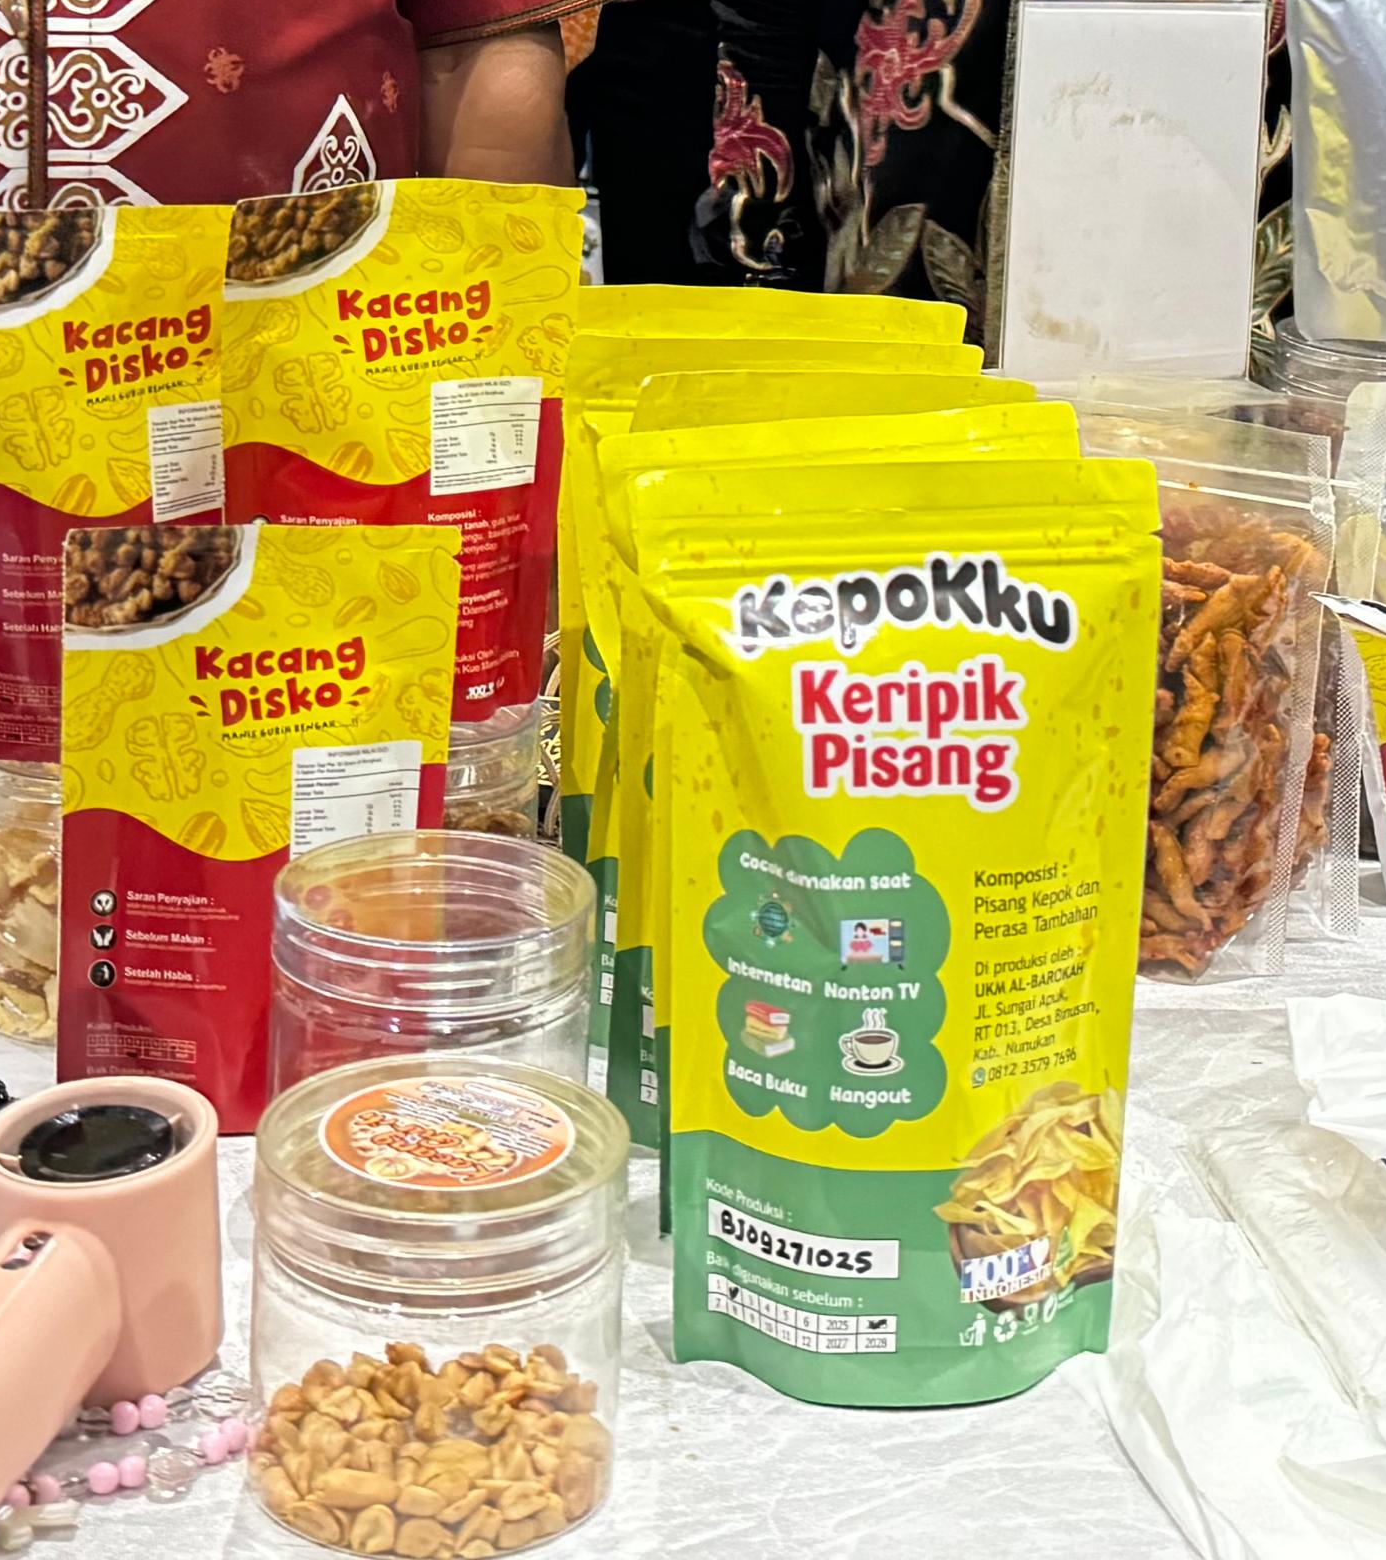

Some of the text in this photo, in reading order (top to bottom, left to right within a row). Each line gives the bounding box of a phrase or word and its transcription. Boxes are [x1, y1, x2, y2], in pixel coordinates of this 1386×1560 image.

[337, 280, 491, 321] Kacang
[62, 304, 211, 354] Kacang
[362, 319, 469, 363] Disko
[84, 344, 189, 393] Disko
[194, 636, 366, 682] Kacang
[220, 678, 342, 727] Disko
[799, 662, 1019, 739] Keripik
[812, 733, 1012, 803] Pisang
[870, 871, 912, 890] saat
[974, 862, 1058, 889] Komposisi
[127, 890, 208, 906] Saran Penyajian
[974, 880, 1099, 914] Pisang Kepok dan
[125, 930, 205, 945] Sebelum Makan
[974, 904, 1098, 940] Perasa Tambahan
[124, 966, 193, 982] Setelah Habis
[728, 957, 813, 995] Internetan
[975, 961, 988, 976] Di
[993, 952, 1047, 977] produksi
[975, 961, 1084, 998] UKM AL-BAROKAH
[824, 980, 921, 1001] Nonton TV
[996, 996, 1036, 1016] Sungai
[974, 1025, 992, 1041] RT
[1025, 1014, 1052, 1031] Desa
[1005, 1033, 1056, 1056] Nunukan
[728, 1059, 807, 1099] Baca Buku
[989, 1062, 1017, 1081] 0812
[829, 1085, 912, 1109] Hangout
[706, 1178, 784, 1219] Kode Produksi
[720, 1209, 873, 1274] BJ09271025
[793, 1288, 854, 1308] sebelum
[826, 1319, 849, 1330] 2025
